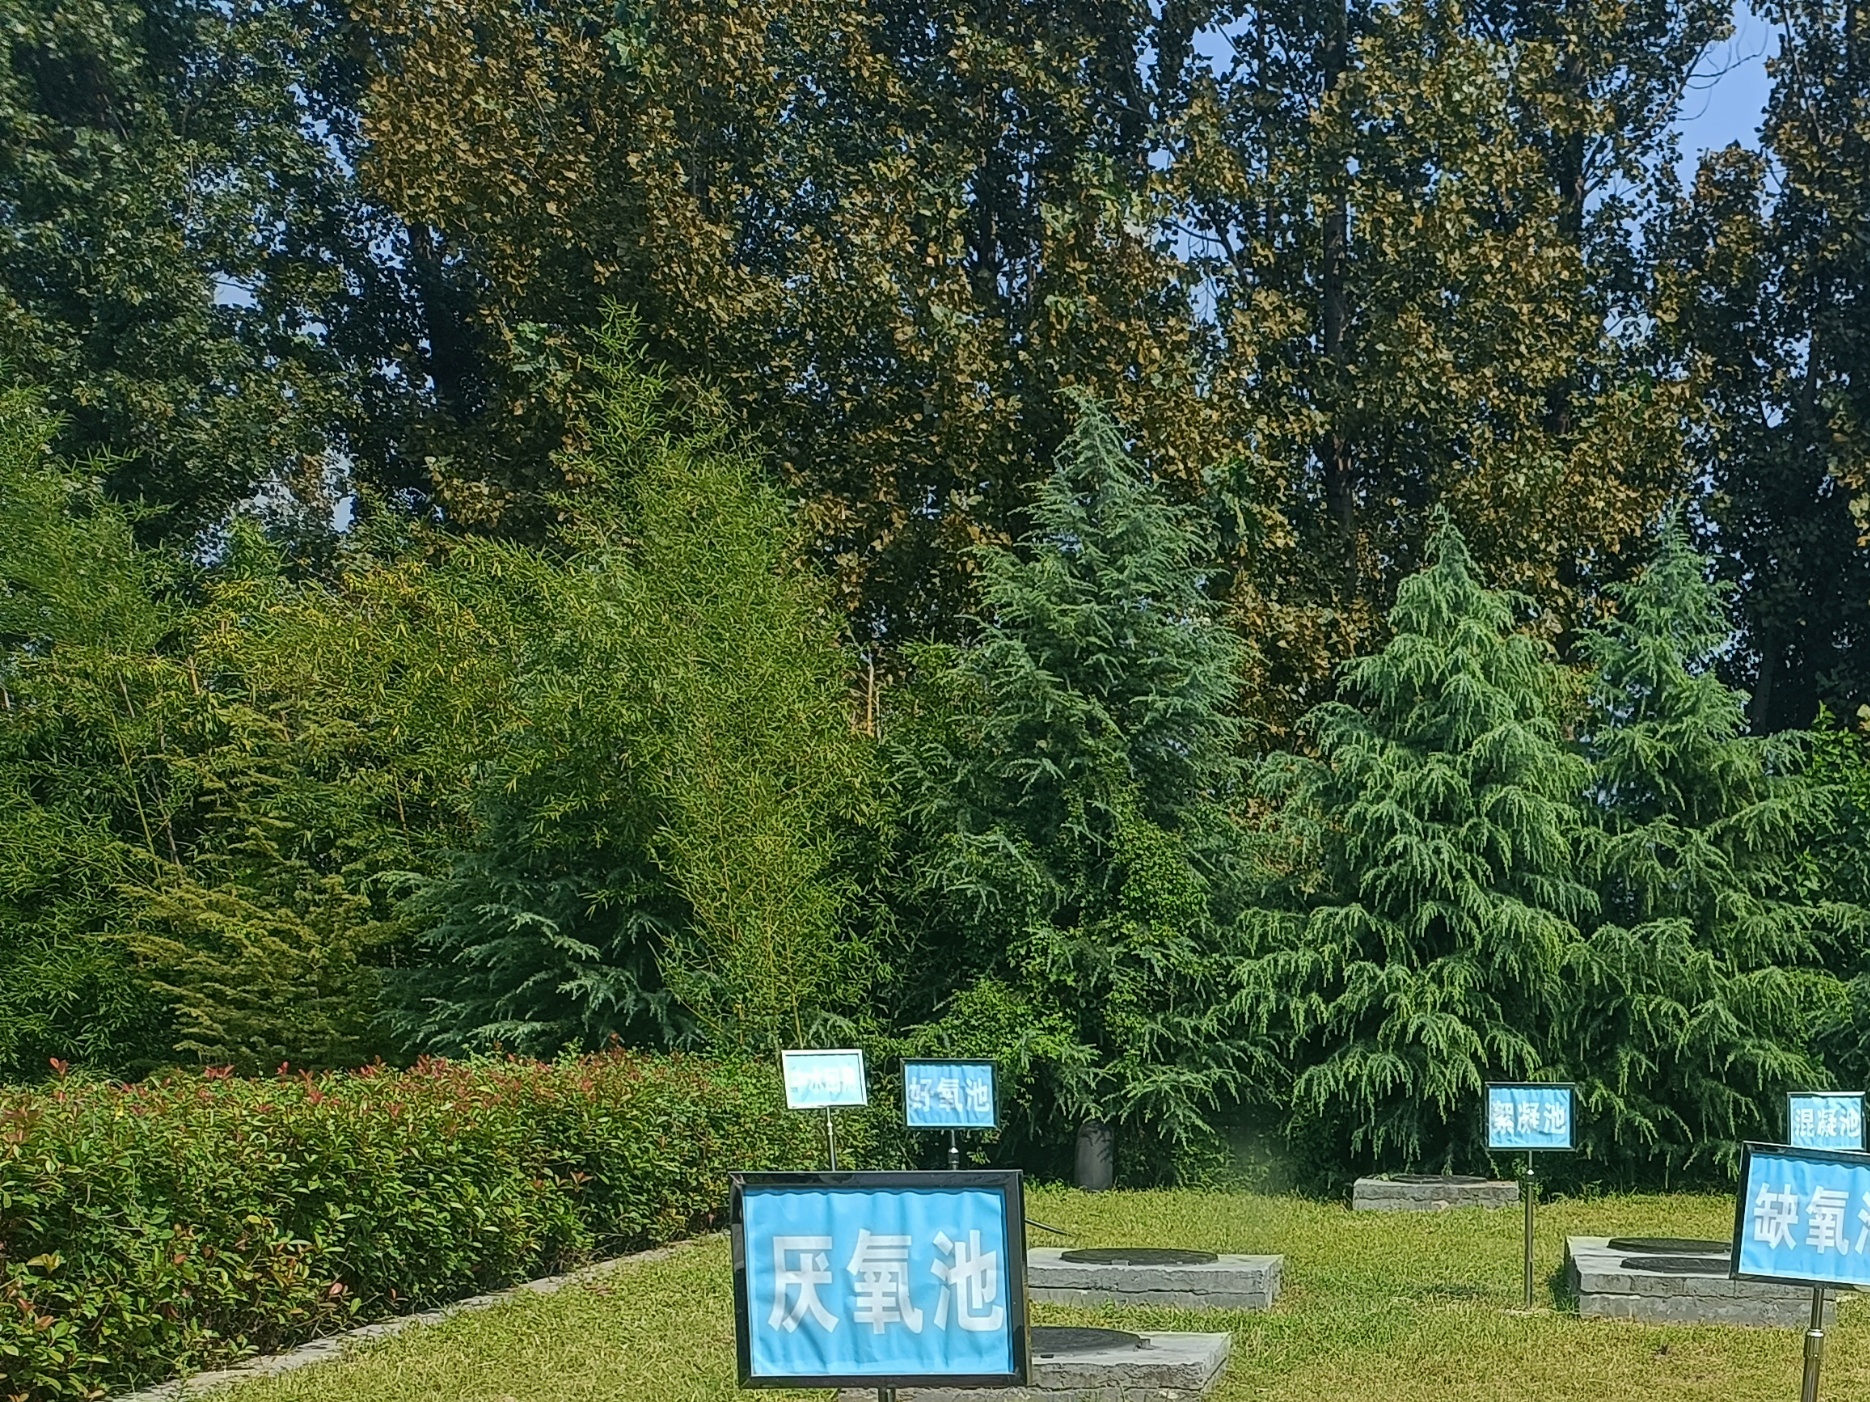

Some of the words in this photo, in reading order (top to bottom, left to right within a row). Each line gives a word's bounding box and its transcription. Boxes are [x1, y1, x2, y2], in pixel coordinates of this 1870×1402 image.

[908, 1076, 990, 1112] 好氧池
[1492, 1100, 1567, 1135] 絮凝池
[1794, 1107, 1861, 1137] 混凝池
[767, 1228, 1004, 1335] 厌氧池
